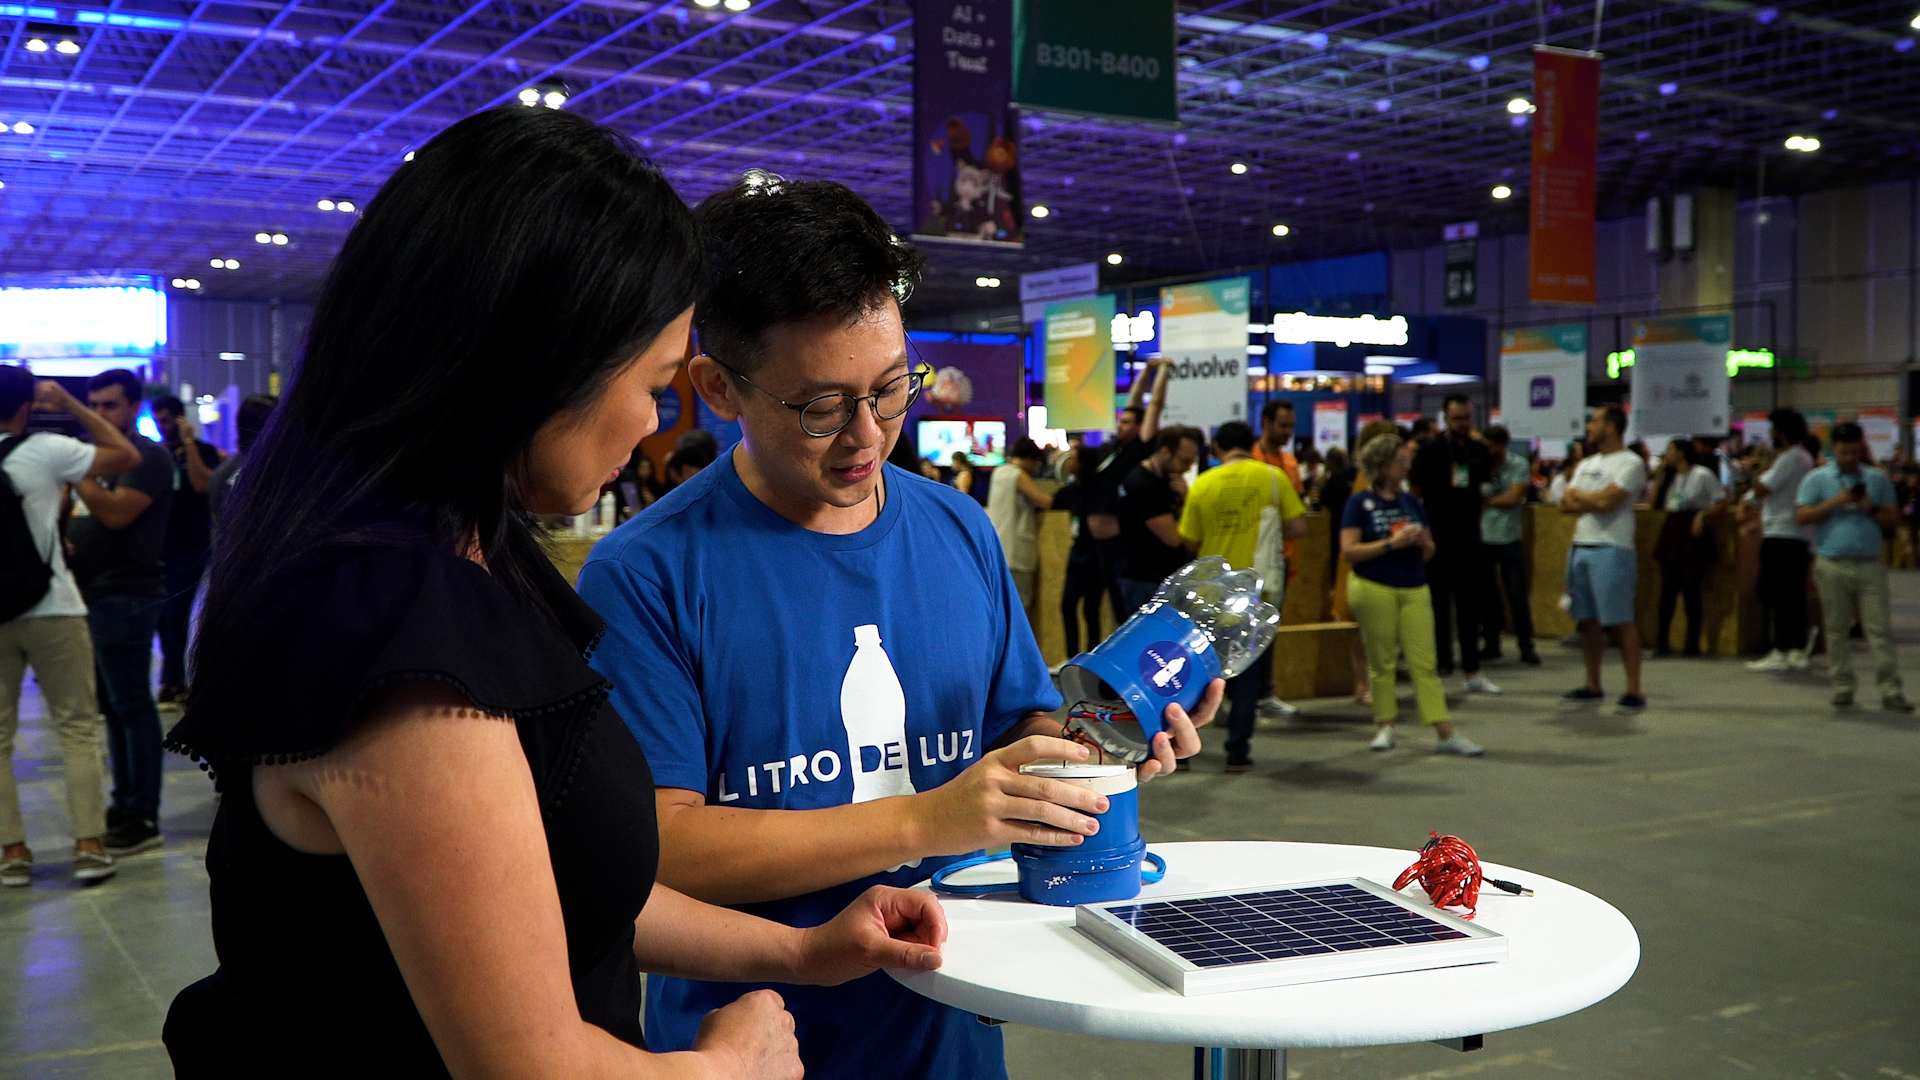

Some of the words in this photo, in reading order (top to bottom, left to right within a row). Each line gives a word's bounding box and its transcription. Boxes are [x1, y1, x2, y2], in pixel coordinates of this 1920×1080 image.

[942, 26, 982, 47] Data
[1037, 43, 1160, 79] B301-B400
[719, 750, 841, 802] LITRO
[859, 742, 903, 774] DE
[919, 729, 974, 767] LUZ
